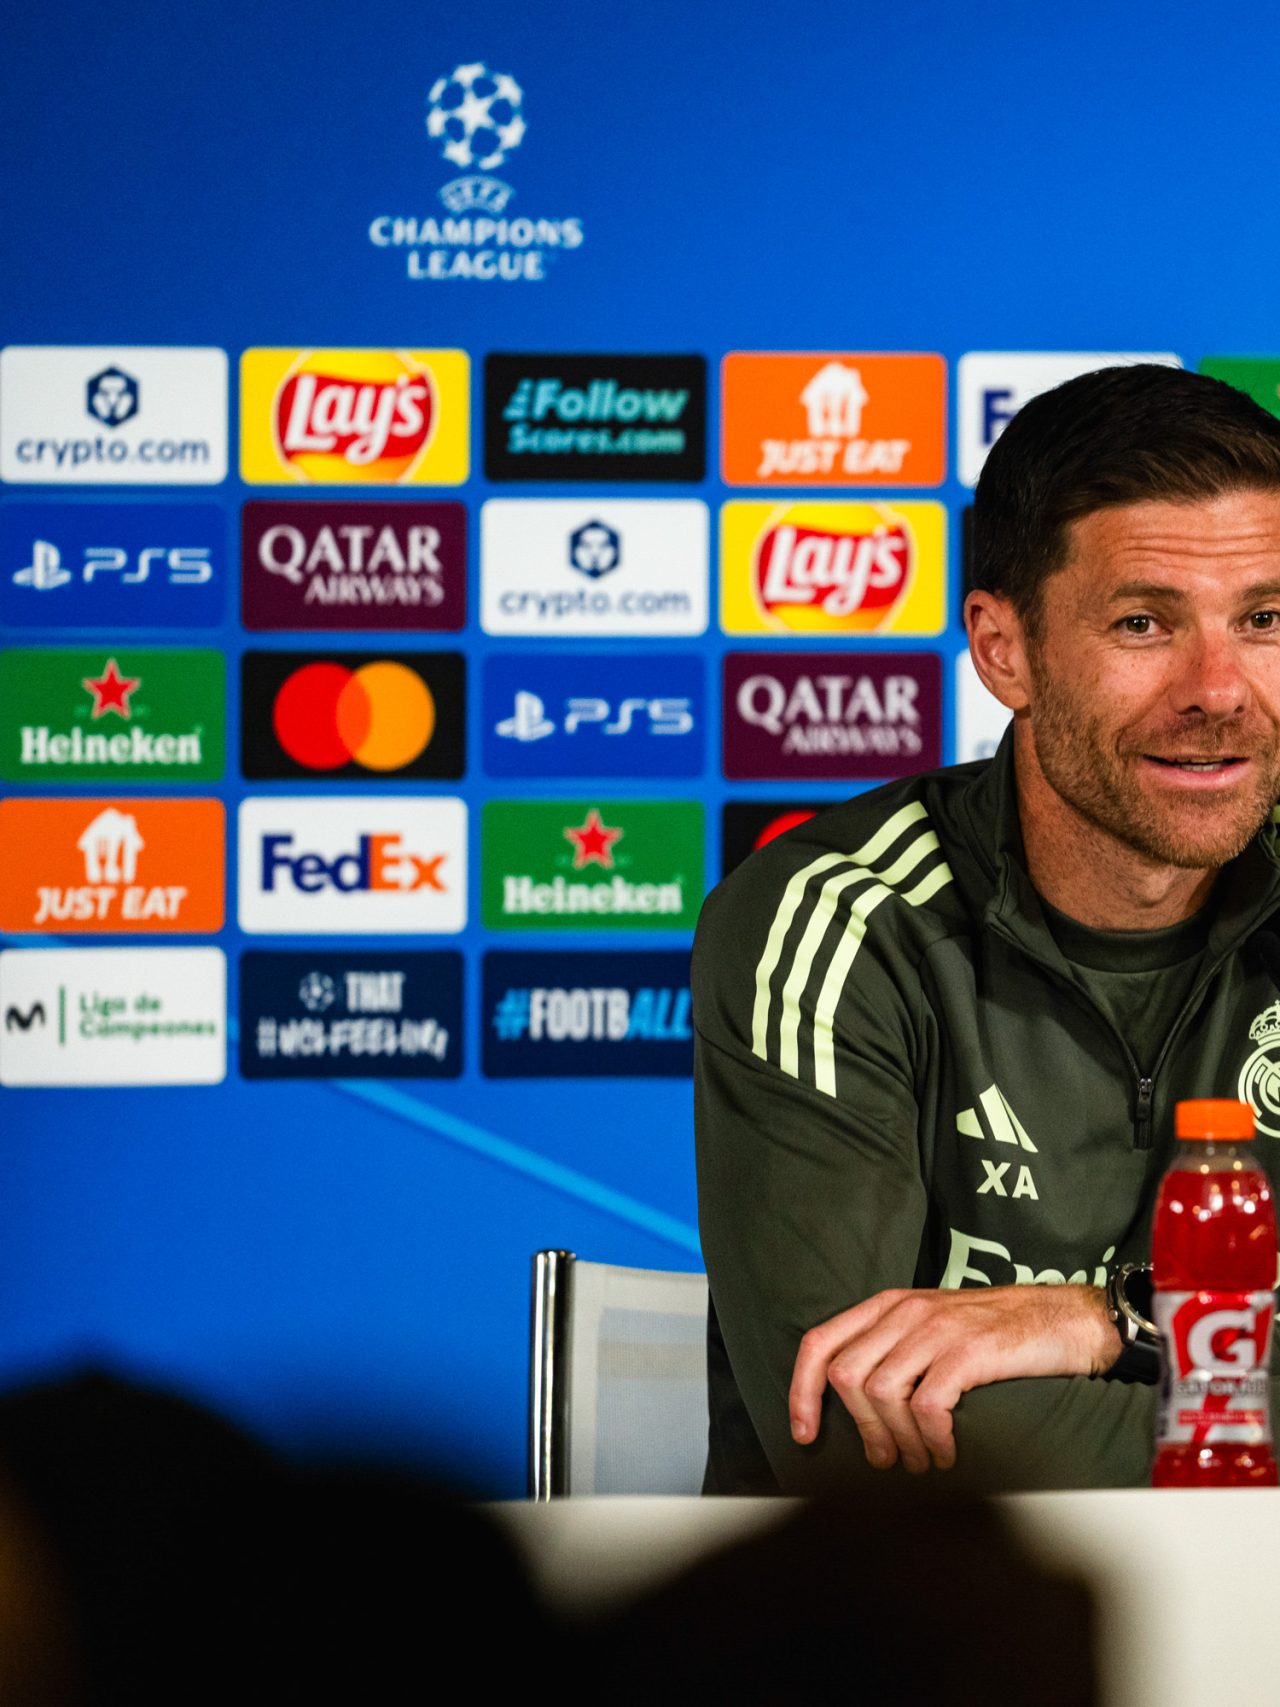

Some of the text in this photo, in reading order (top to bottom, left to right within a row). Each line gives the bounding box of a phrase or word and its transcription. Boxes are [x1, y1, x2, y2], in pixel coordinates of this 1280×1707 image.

[369, 217, 583, 248] CHAMPIONS
[408, 251, 543, 280] LEAGUE
[284, 372, 428, 464] Lay's
[16, 437, 209, 469] crypto.com
[758, 441, 910, 477] JUST EAT
[83, 548, 212, 583] PS5
[258, 525, 442, 584] QATAR
[761, 524, 908, 614] Lay's
[303, 573, 445, 606] AIRWAYS
[498, 587, 692, 620] crypto.com
[565, 699, 693, 734] PS5
[737, 676, 918, 735] QATAR
[21, 726, 203, 764] Heineken
[783, 725, 923, 756] AIRWAYS
[261, 833, 447, 894] FedEx
[34, 887, 188, 924] JUST EAT
[502, 875, 684, 914] Heineken
[493, 987, 692, 1041] #FOOTBALL
[976, 1159, 1039, 1200] XA
[1187, 1308, 1258, 1377] G
